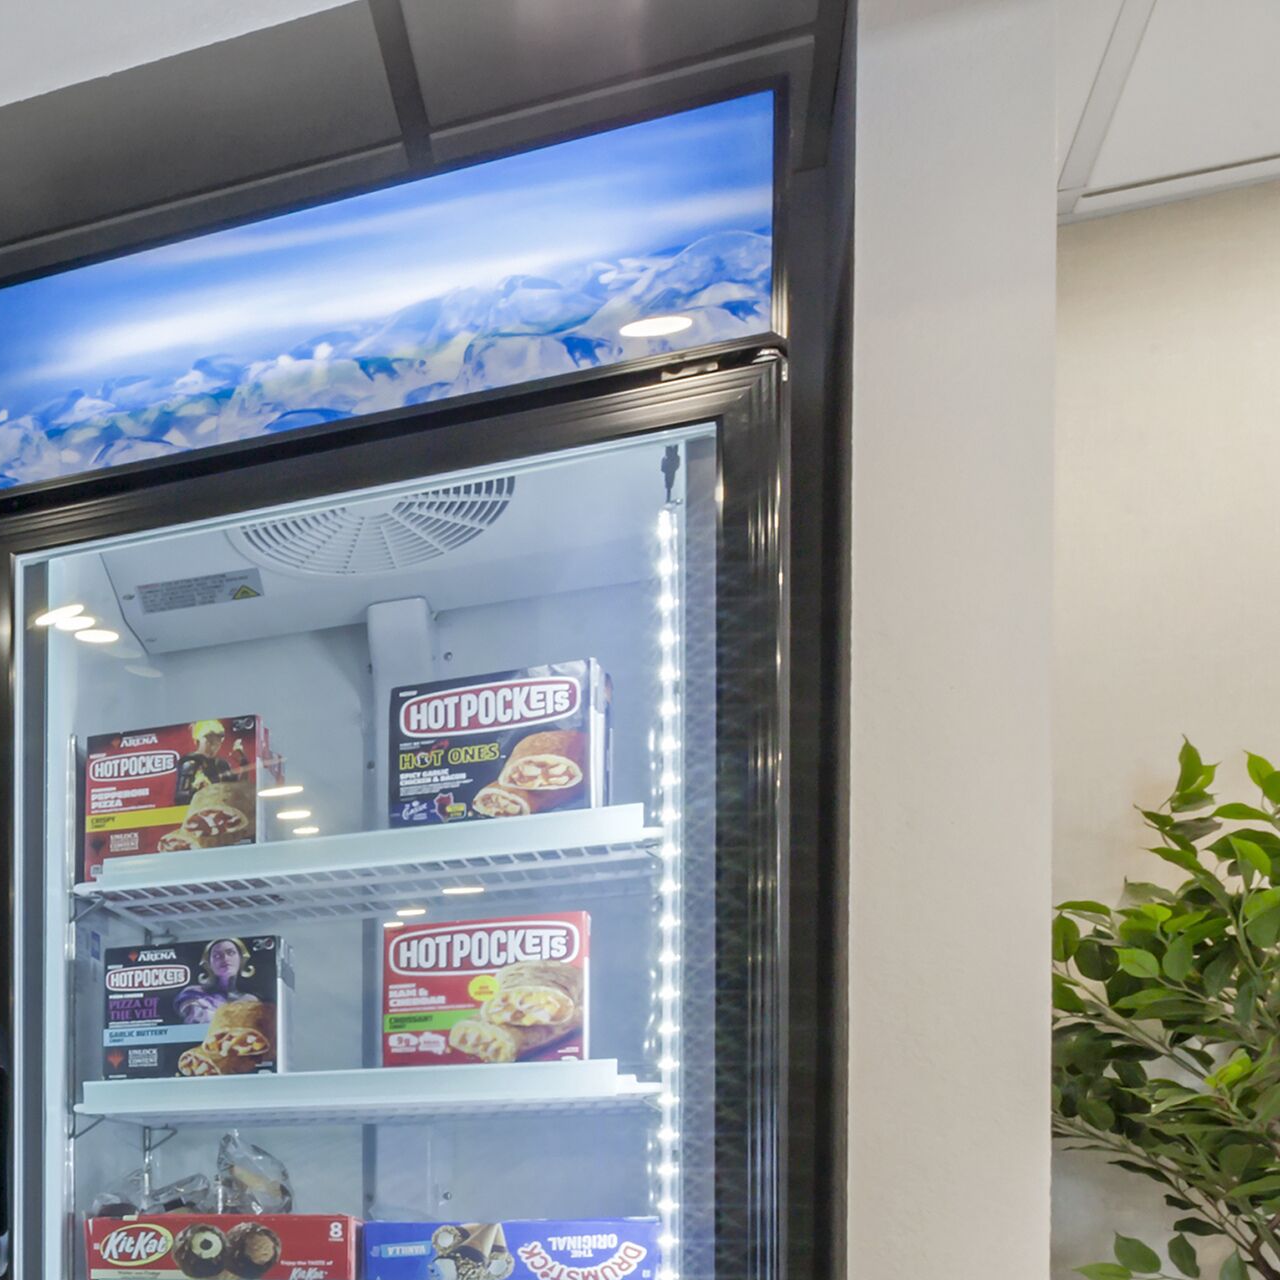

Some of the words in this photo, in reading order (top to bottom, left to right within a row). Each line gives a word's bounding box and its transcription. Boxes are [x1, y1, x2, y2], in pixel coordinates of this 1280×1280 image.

[120, 735, 158, 748] ARENA
[400, 749, 445, 770] HOT
[448, 742, 500, 765] ONES
[138, 951, 177, 962] ARENA
[109, 998, 142, 1010] PIZZA
[142, 997, 159, 1009] OF
[109, 1009, 132, 1021] THE
[109, 1030, 135, 1039] GARLIC
[136, 1028, 168, 1037] BUTTERY
[329, 1221, 343, 1238] 8
[547, 1233, 618, 1250] ORIGINAL
[386, 1245, 427, 1256] VANILLA
[571, 1248, 594, 1259] THE
